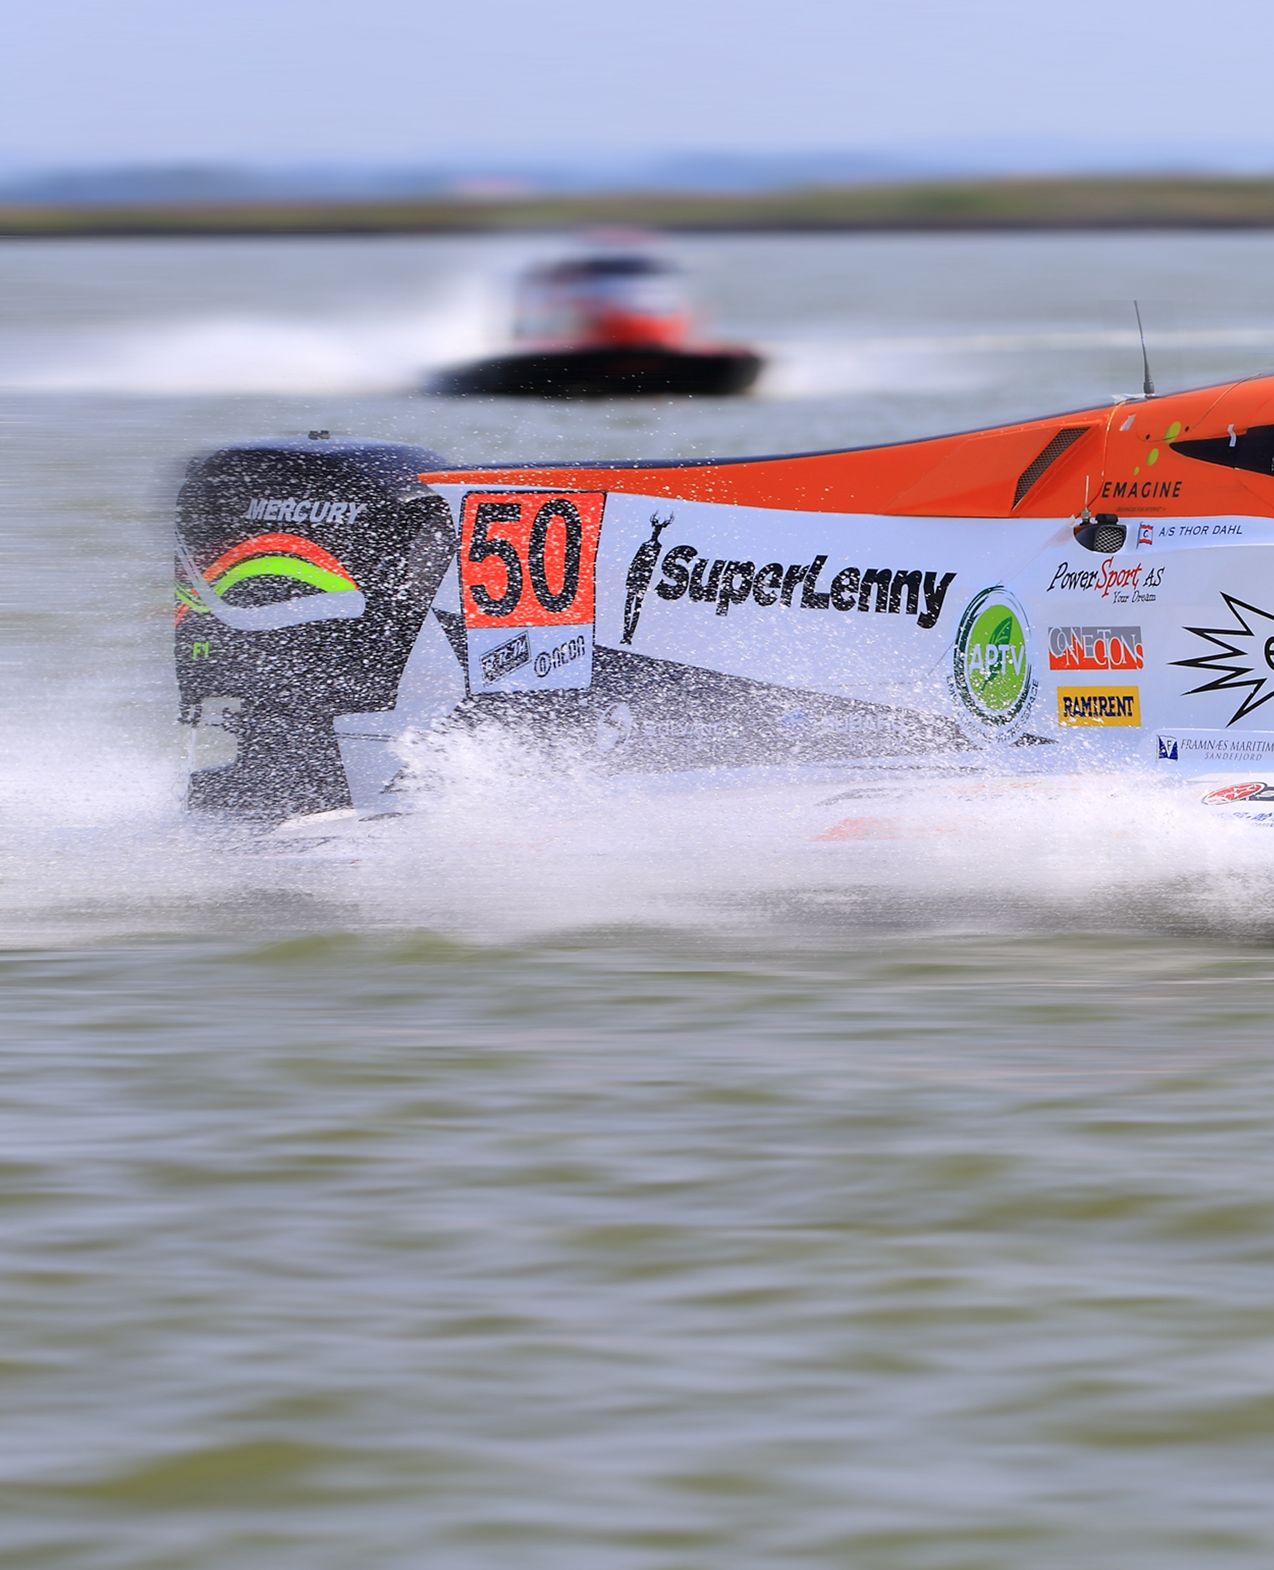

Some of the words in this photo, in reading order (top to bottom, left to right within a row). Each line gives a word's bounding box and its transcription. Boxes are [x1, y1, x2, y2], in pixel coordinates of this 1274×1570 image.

[1101, 481, 1182, 498] EMAGINE
[246, 499, 367, 525] MERCURY
[1158, 526, 1176, 537] A/S
[1179, 525, 1210, 537] THOR
[1212, 525, 1243, 535] DAHL
[467, 498, 583, 618] 50
[655, 544, 957, 629] SuperLenny
[1143, 567, 1165, 588] AS
[1113, 590, 1129, 604] Your
[1132, 589, 1157, 603] Dream
[969, 643, 1025, 676] APTV
[1062, 695, 1134, 718] RAMIRENT
[1204, 751, 1262, 761] SANDEFJORD
